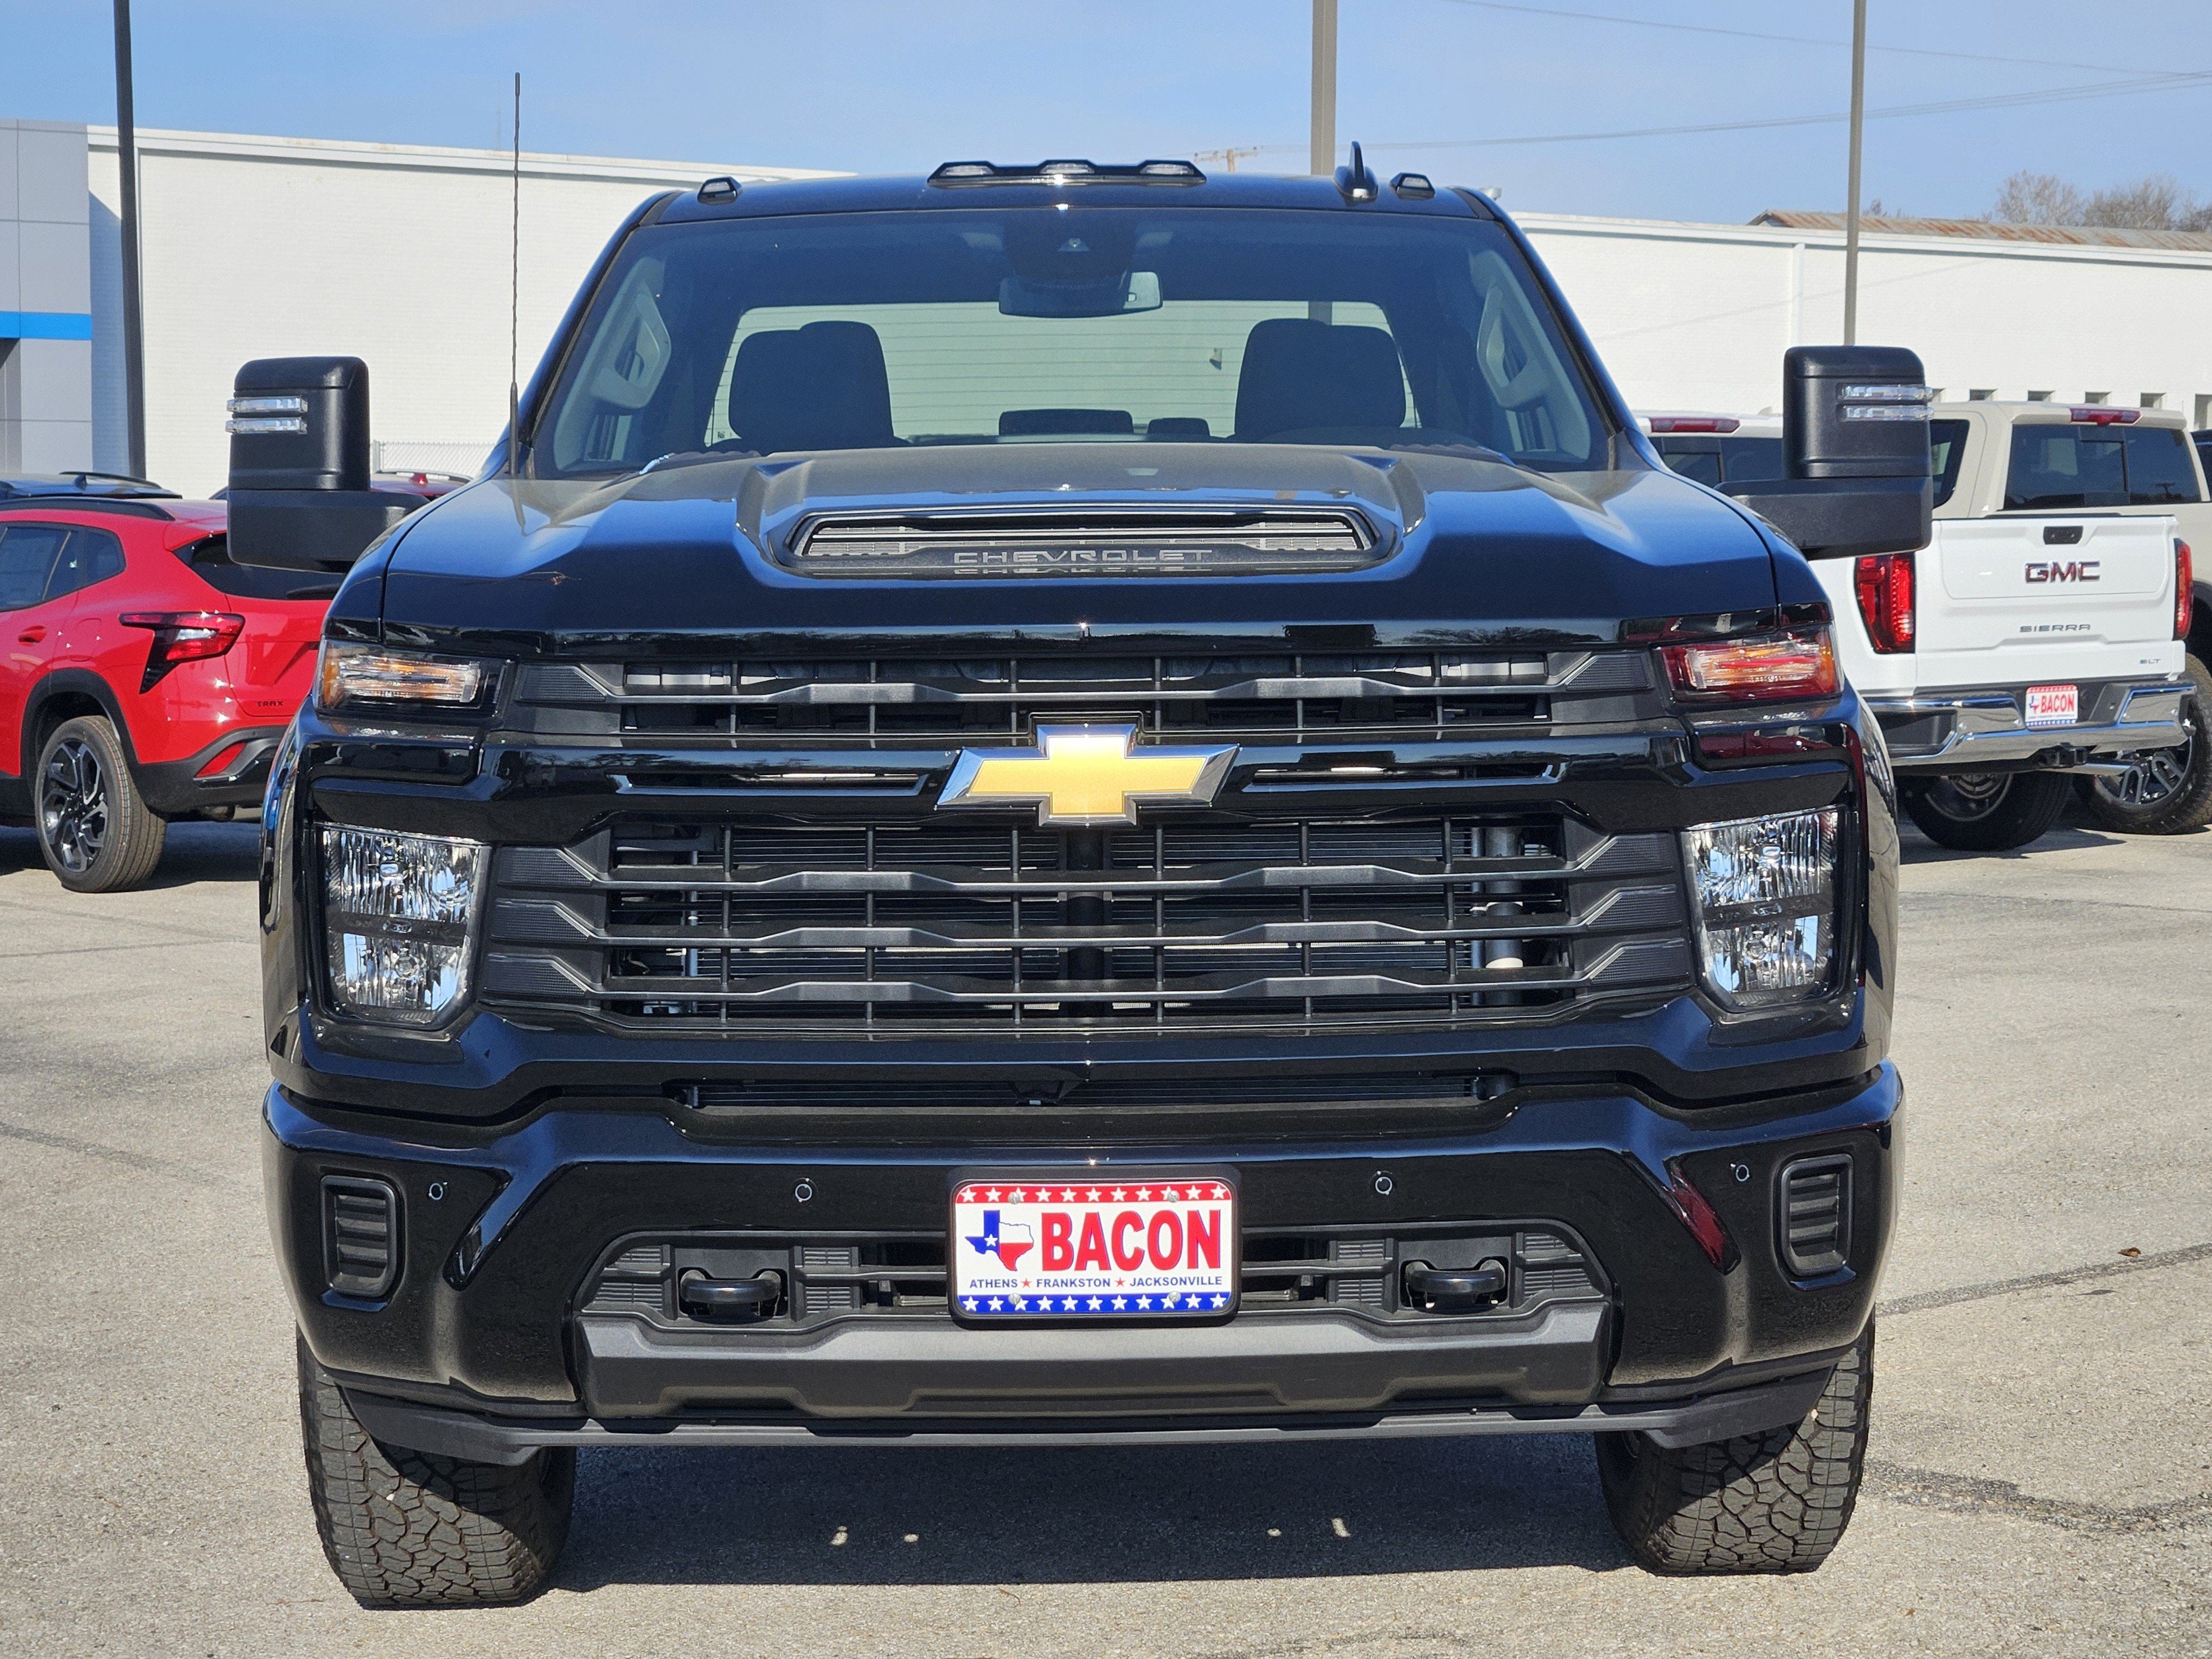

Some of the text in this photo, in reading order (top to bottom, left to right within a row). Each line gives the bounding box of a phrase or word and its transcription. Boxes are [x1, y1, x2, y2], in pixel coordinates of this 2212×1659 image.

[953, 549, 1213, 564] CHEVROLET
[2025, 560, 2100, 584] GMC
[2020, 623, 2091, 632] SIERRA
[2041, 693, 2075, 713] BACON
[1041, 1209, 1221, 1272] BACON
[969, 1276, 1222, 1289] ATHENS FRANKSTON JACKSONVILLE
